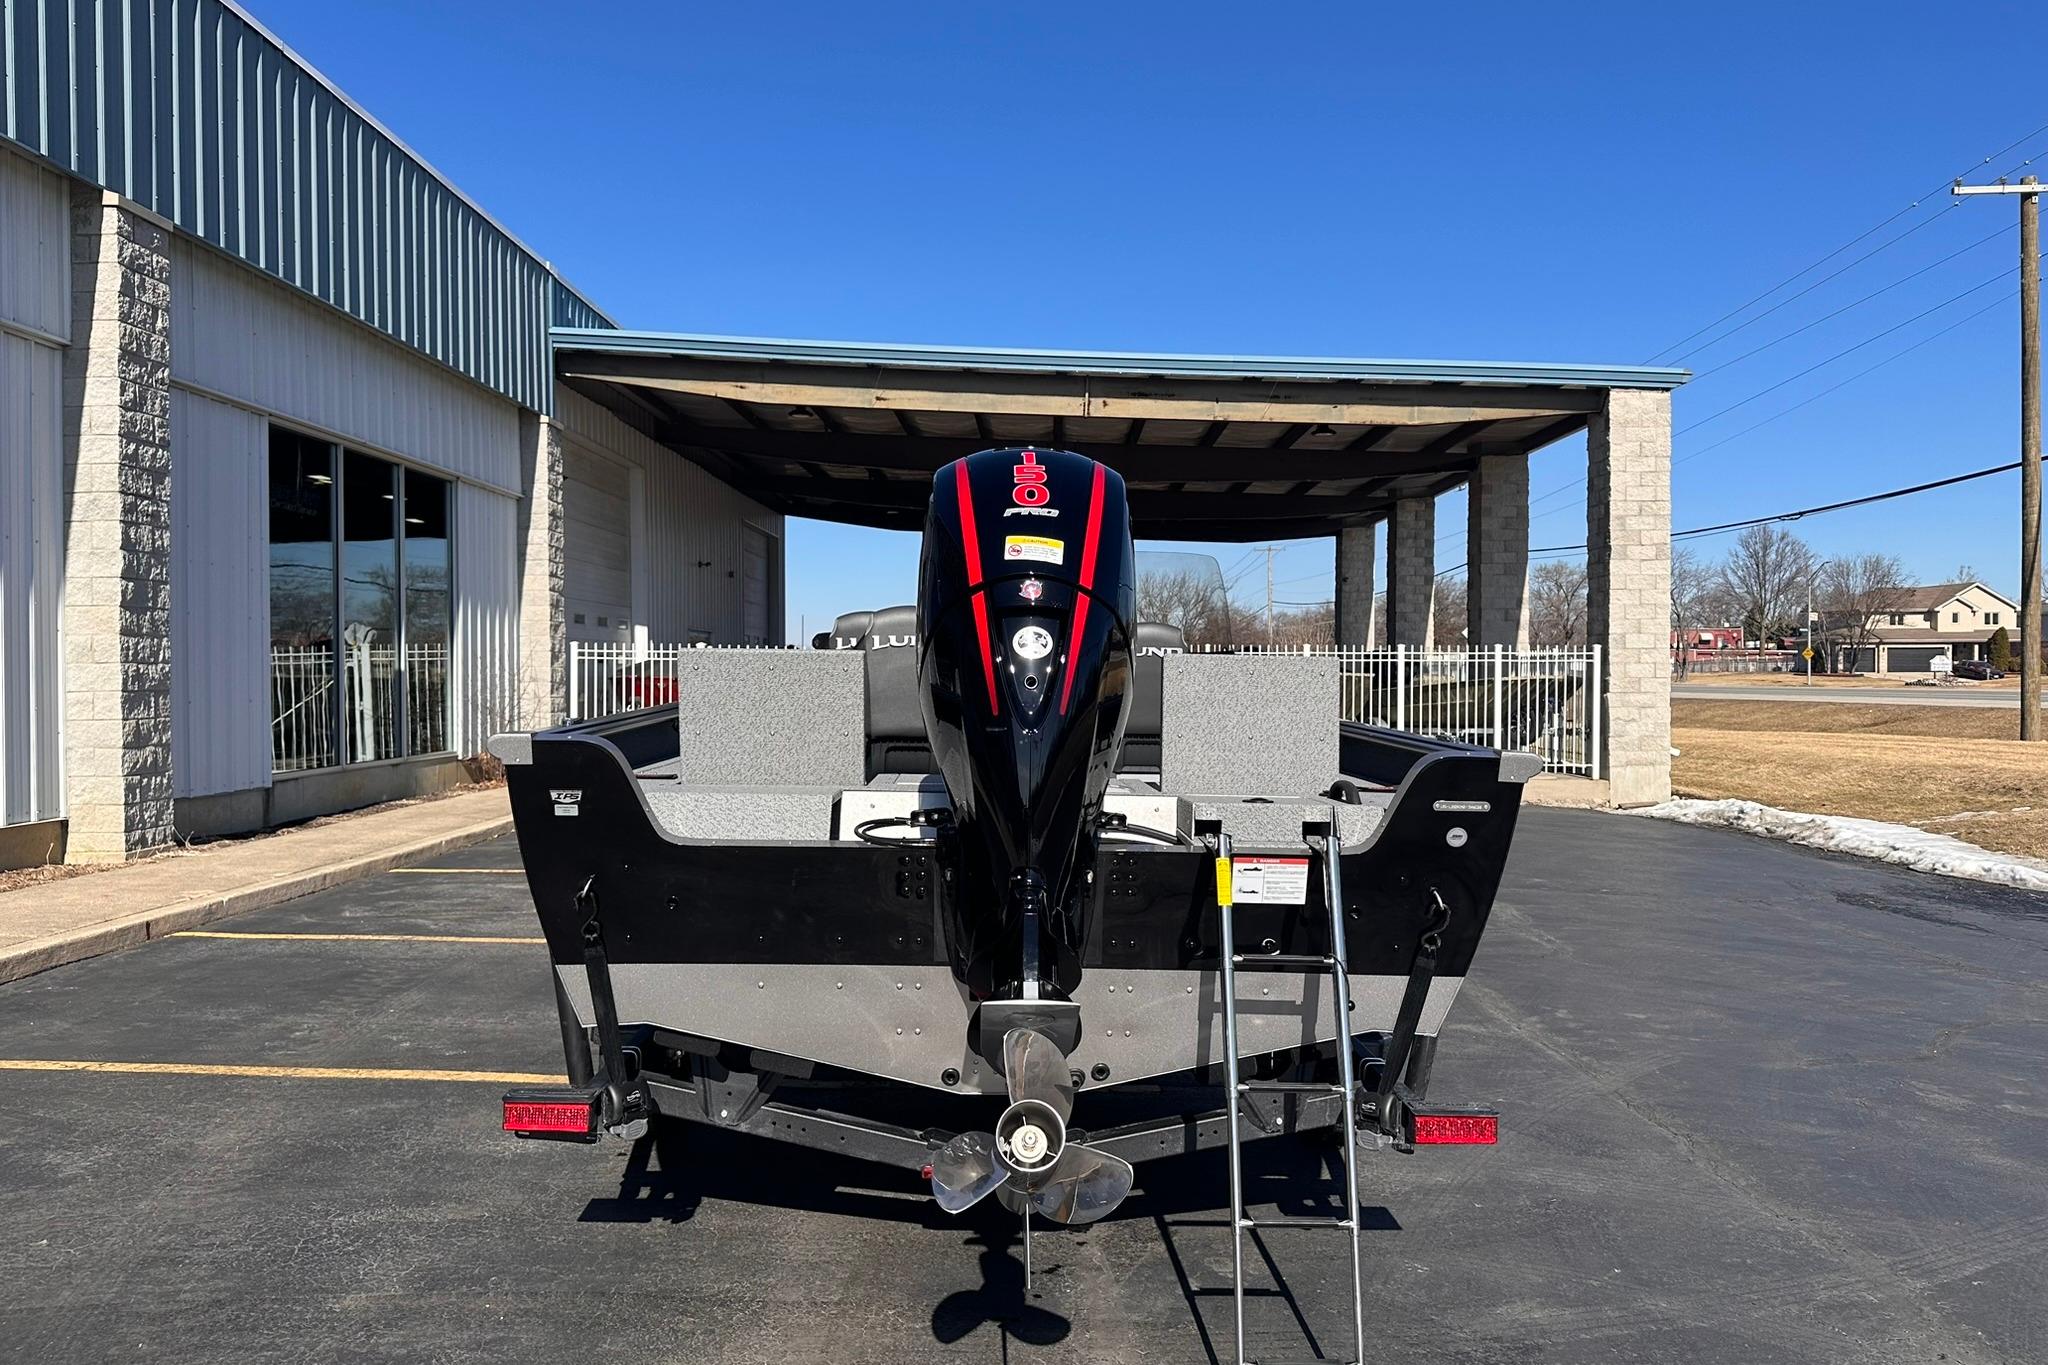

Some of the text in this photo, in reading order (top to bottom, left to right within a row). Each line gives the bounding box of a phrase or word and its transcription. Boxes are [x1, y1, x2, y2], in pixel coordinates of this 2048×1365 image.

[1012, 452, 1050, 507] 150
[1003, 507, 1060, 517] PRO
[871, 634, 916, 650] LU
[554, 792, 581, 800] IPS
